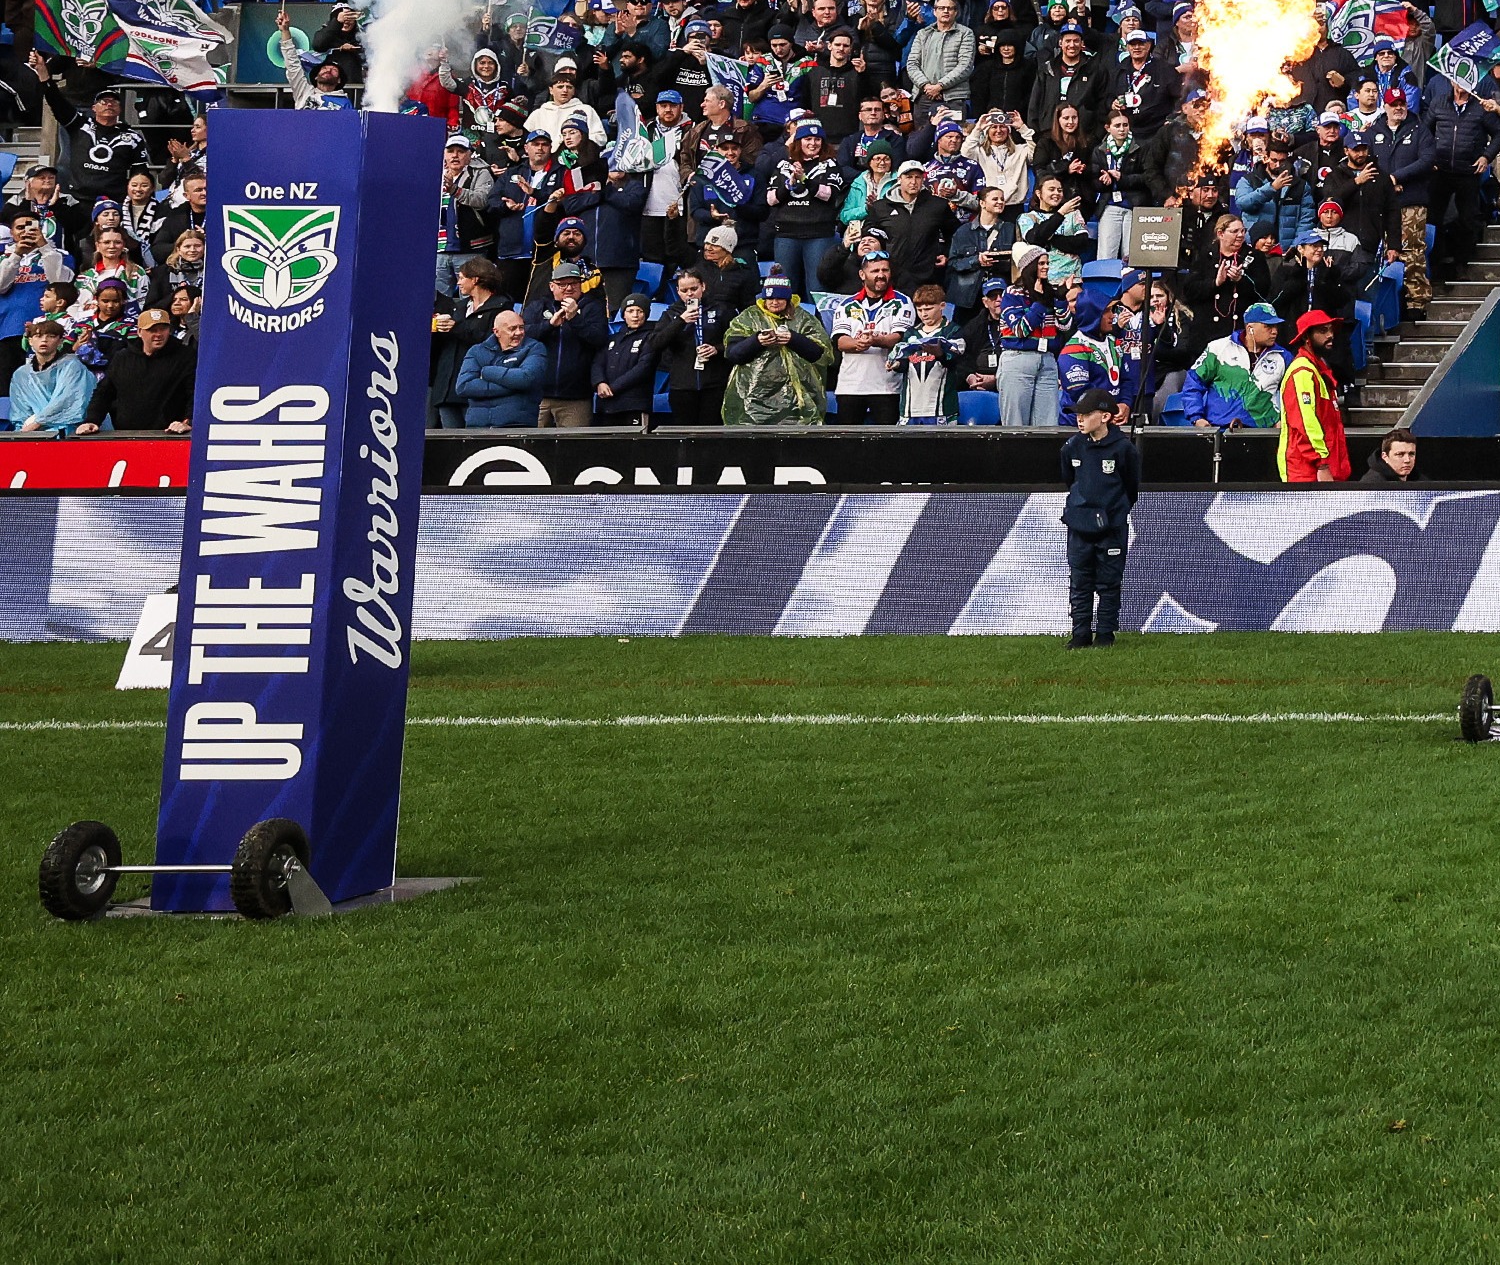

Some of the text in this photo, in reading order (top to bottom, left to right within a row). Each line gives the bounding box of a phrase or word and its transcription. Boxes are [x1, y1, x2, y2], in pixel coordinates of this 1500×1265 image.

[84, 162, 109, 172] one.nz
[245, 182, 318, 200] One NZ
[227, 294, 325, 333] WARRIORS
[346, 331, 402, 670] Warriors
[179, 385, 330, 781] UP THE WAHS
